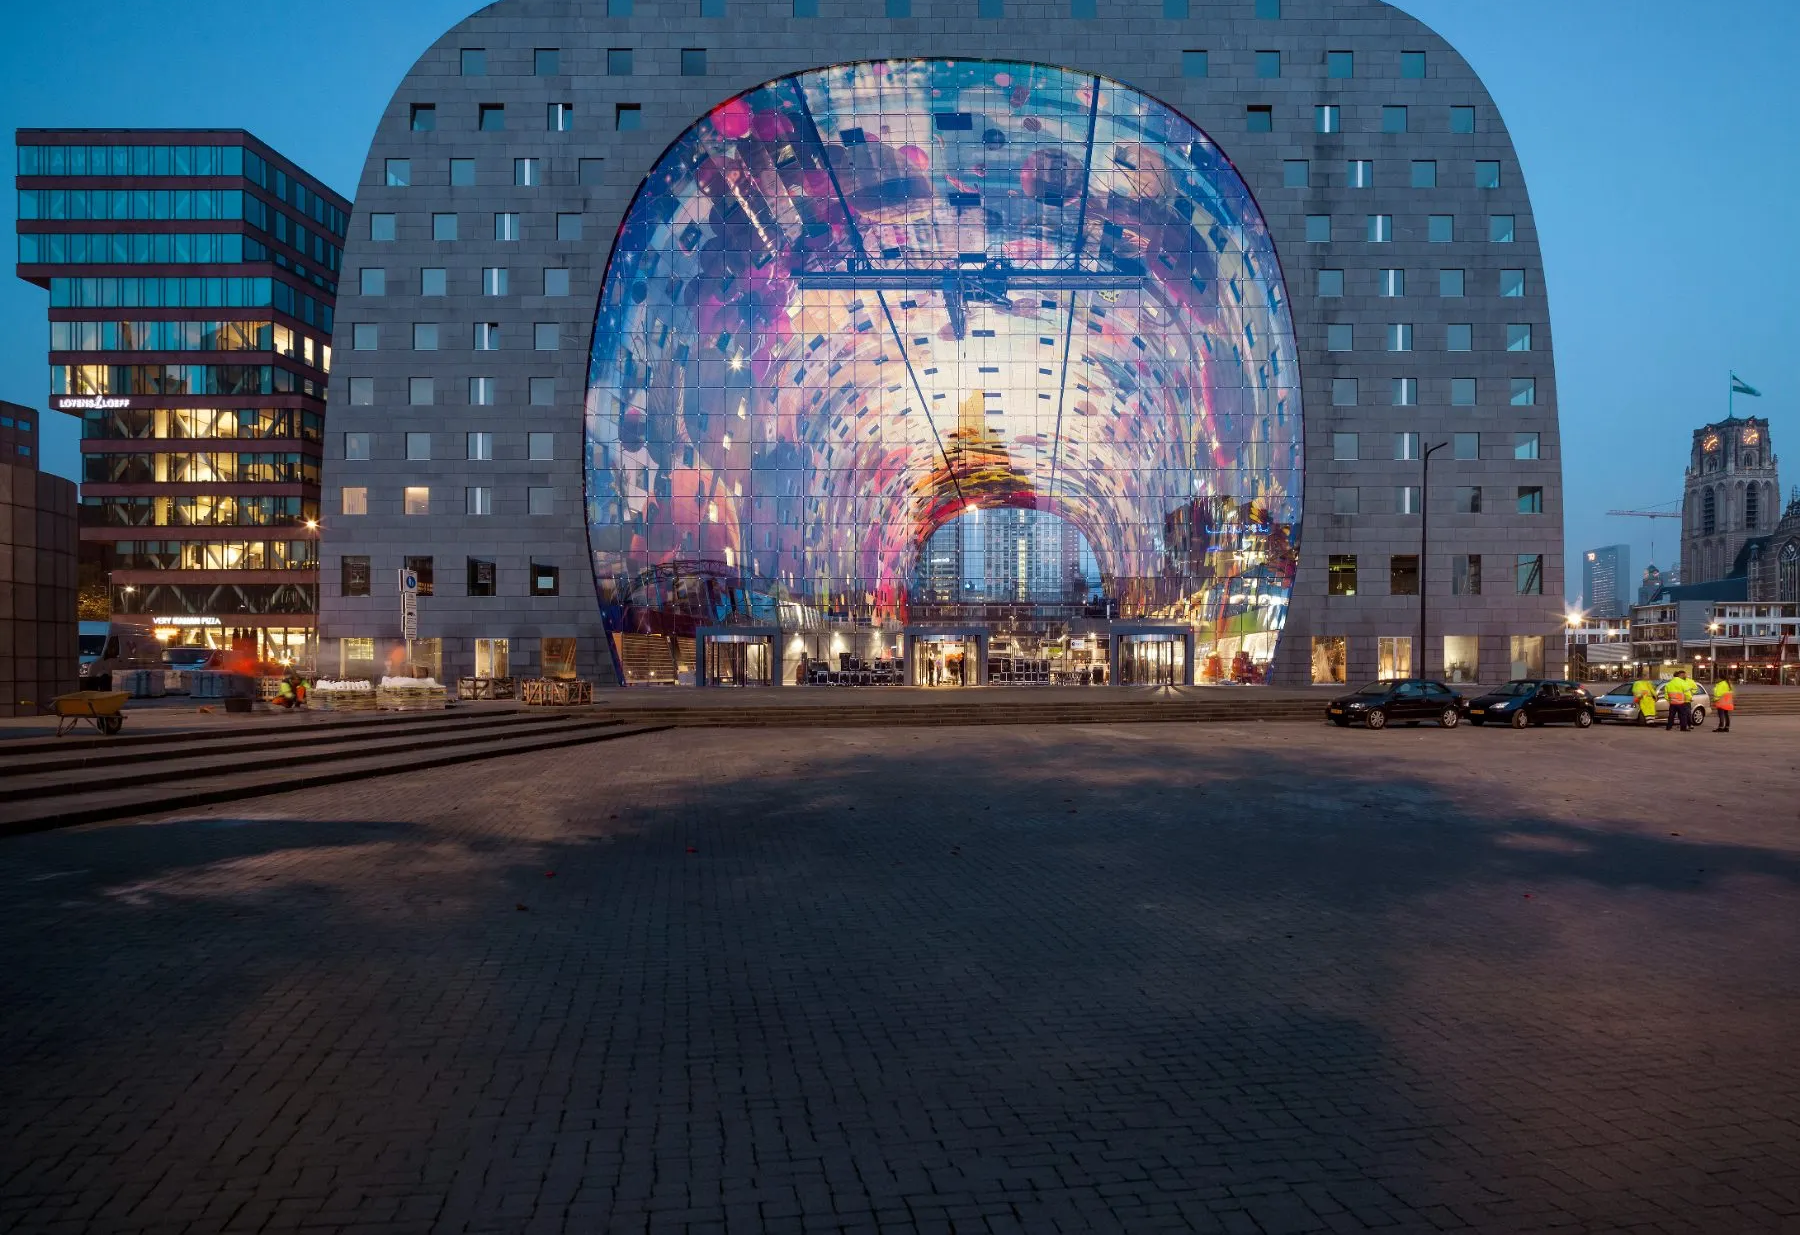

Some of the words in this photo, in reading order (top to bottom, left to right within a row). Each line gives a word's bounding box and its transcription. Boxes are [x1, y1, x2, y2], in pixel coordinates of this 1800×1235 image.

[59, 398, 94, 408] LOYENS
[102, 398, 130, 408] LOEFF
[152, 617, 172, 625] VERY
[201, 617, 222, 625] PIZZA
